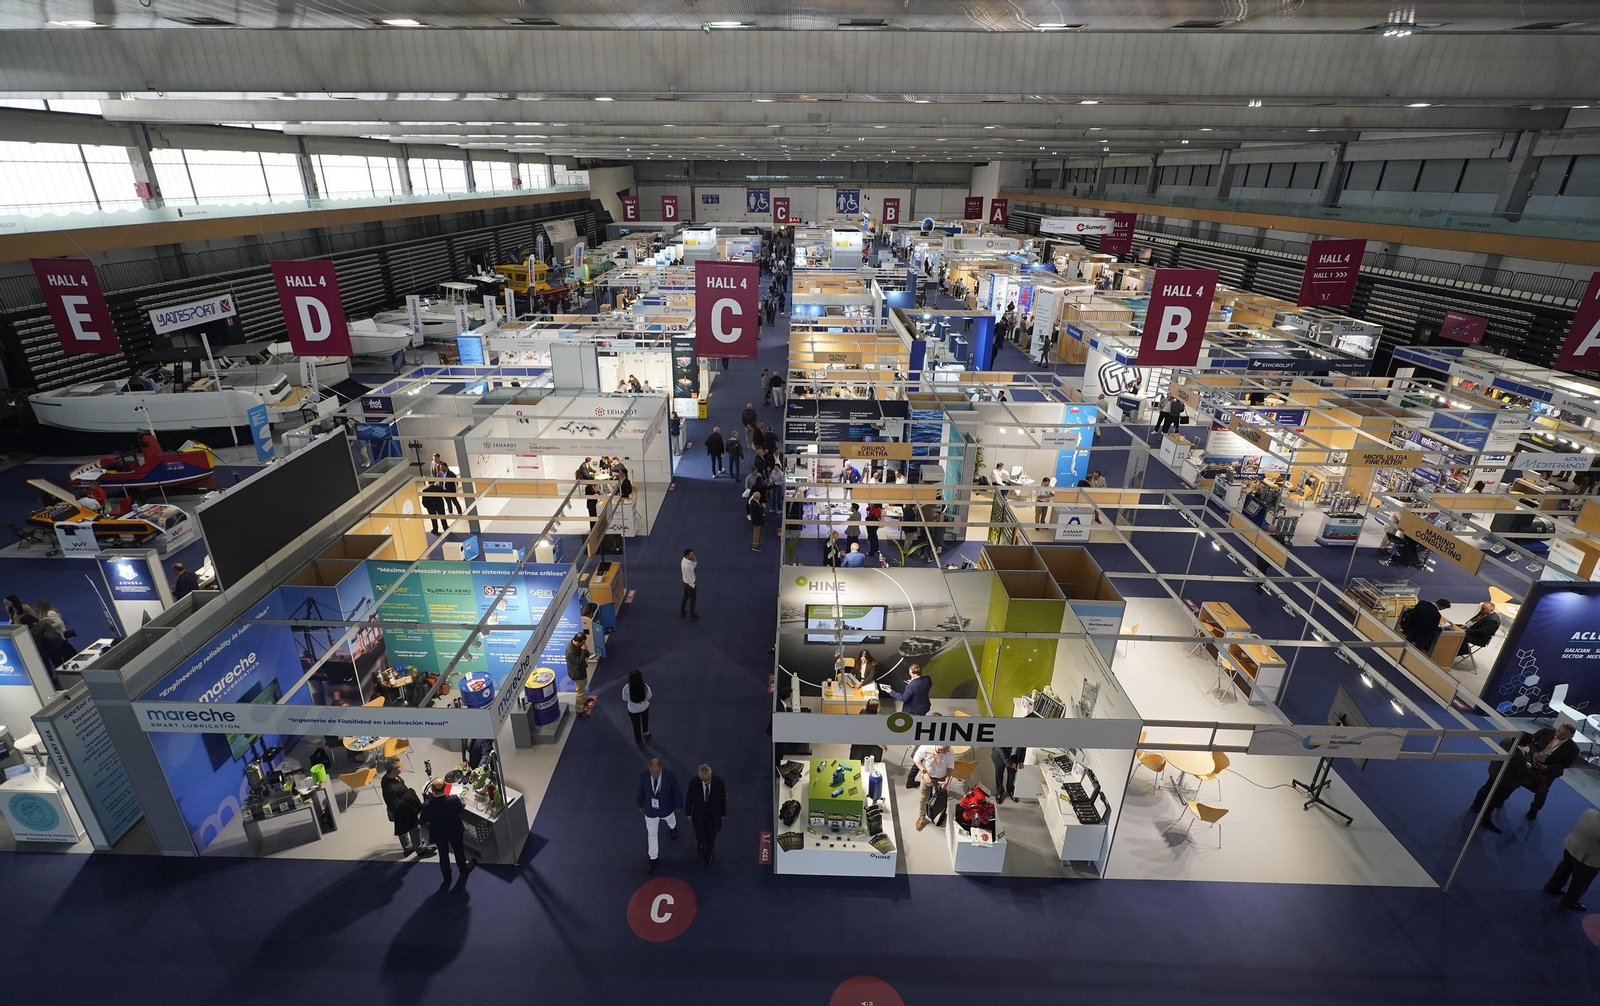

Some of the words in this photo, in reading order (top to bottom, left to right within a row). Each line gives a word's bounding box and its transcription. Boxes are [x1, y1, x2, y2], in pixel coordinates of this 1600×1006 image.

[627, 206, 635, 218] E
[666, 205, 674, 217] D
[778, 207, 786, 219] C
[887, 207, 896, 220] B
[993, 208, 1002, 221] A
[1319, 254, 1342, 264] HALL
[1343, 254, 1350, 263] 4
[47, 275, 78, 287] HALL
[80, 275, 88, 286] 4
[285, 276, 317, 287] HALL
[318, 276, 326, 286] 4
[706, 277, 737, 288] HALL
[740, 277, 747, 289] 4
[1163, 285, 1192, 297] HALL
[1195, 286, 1204, 297] 4
[61, 295, 101, 341] E
[156, 303, 215, 327] YATESPORT
[295, 296, 332, 341] D
[711, 298, 742, 343] C
[1155, 306, 1191, 350] B
[1567, 402, 1598, 414] INTERNACIONAL
[1415, 530, 1461, 562] CONSULTING
[1425, 528, 1455, 550] MARINO
[809, 581, 845, 591] HINE
[1571, 632, 1600, 640] ACL
[159, 661, 203, 697] “Engineering
[203, 638, 232, 664] reliability
[198, 651, 257, 703] mareche
[223, 661, 260, 695] LUBRICATION
[498, 655, 530, 716] mareche
[63, 701, 87, 720] Sector
[72, 706, 96, 724] Experien
[146, 708, 236, 722] mareche
[76, 711, 98, 729] corporat
[76, 717, 100, 737] empresar
[86, 722, 103, 738] ejecuti
[914, 722, 996, 742] HINE
[51, 743, 65, 764] TALENT
[62, 766, 71, 777] THE
[650, 893, 674, 923] C
